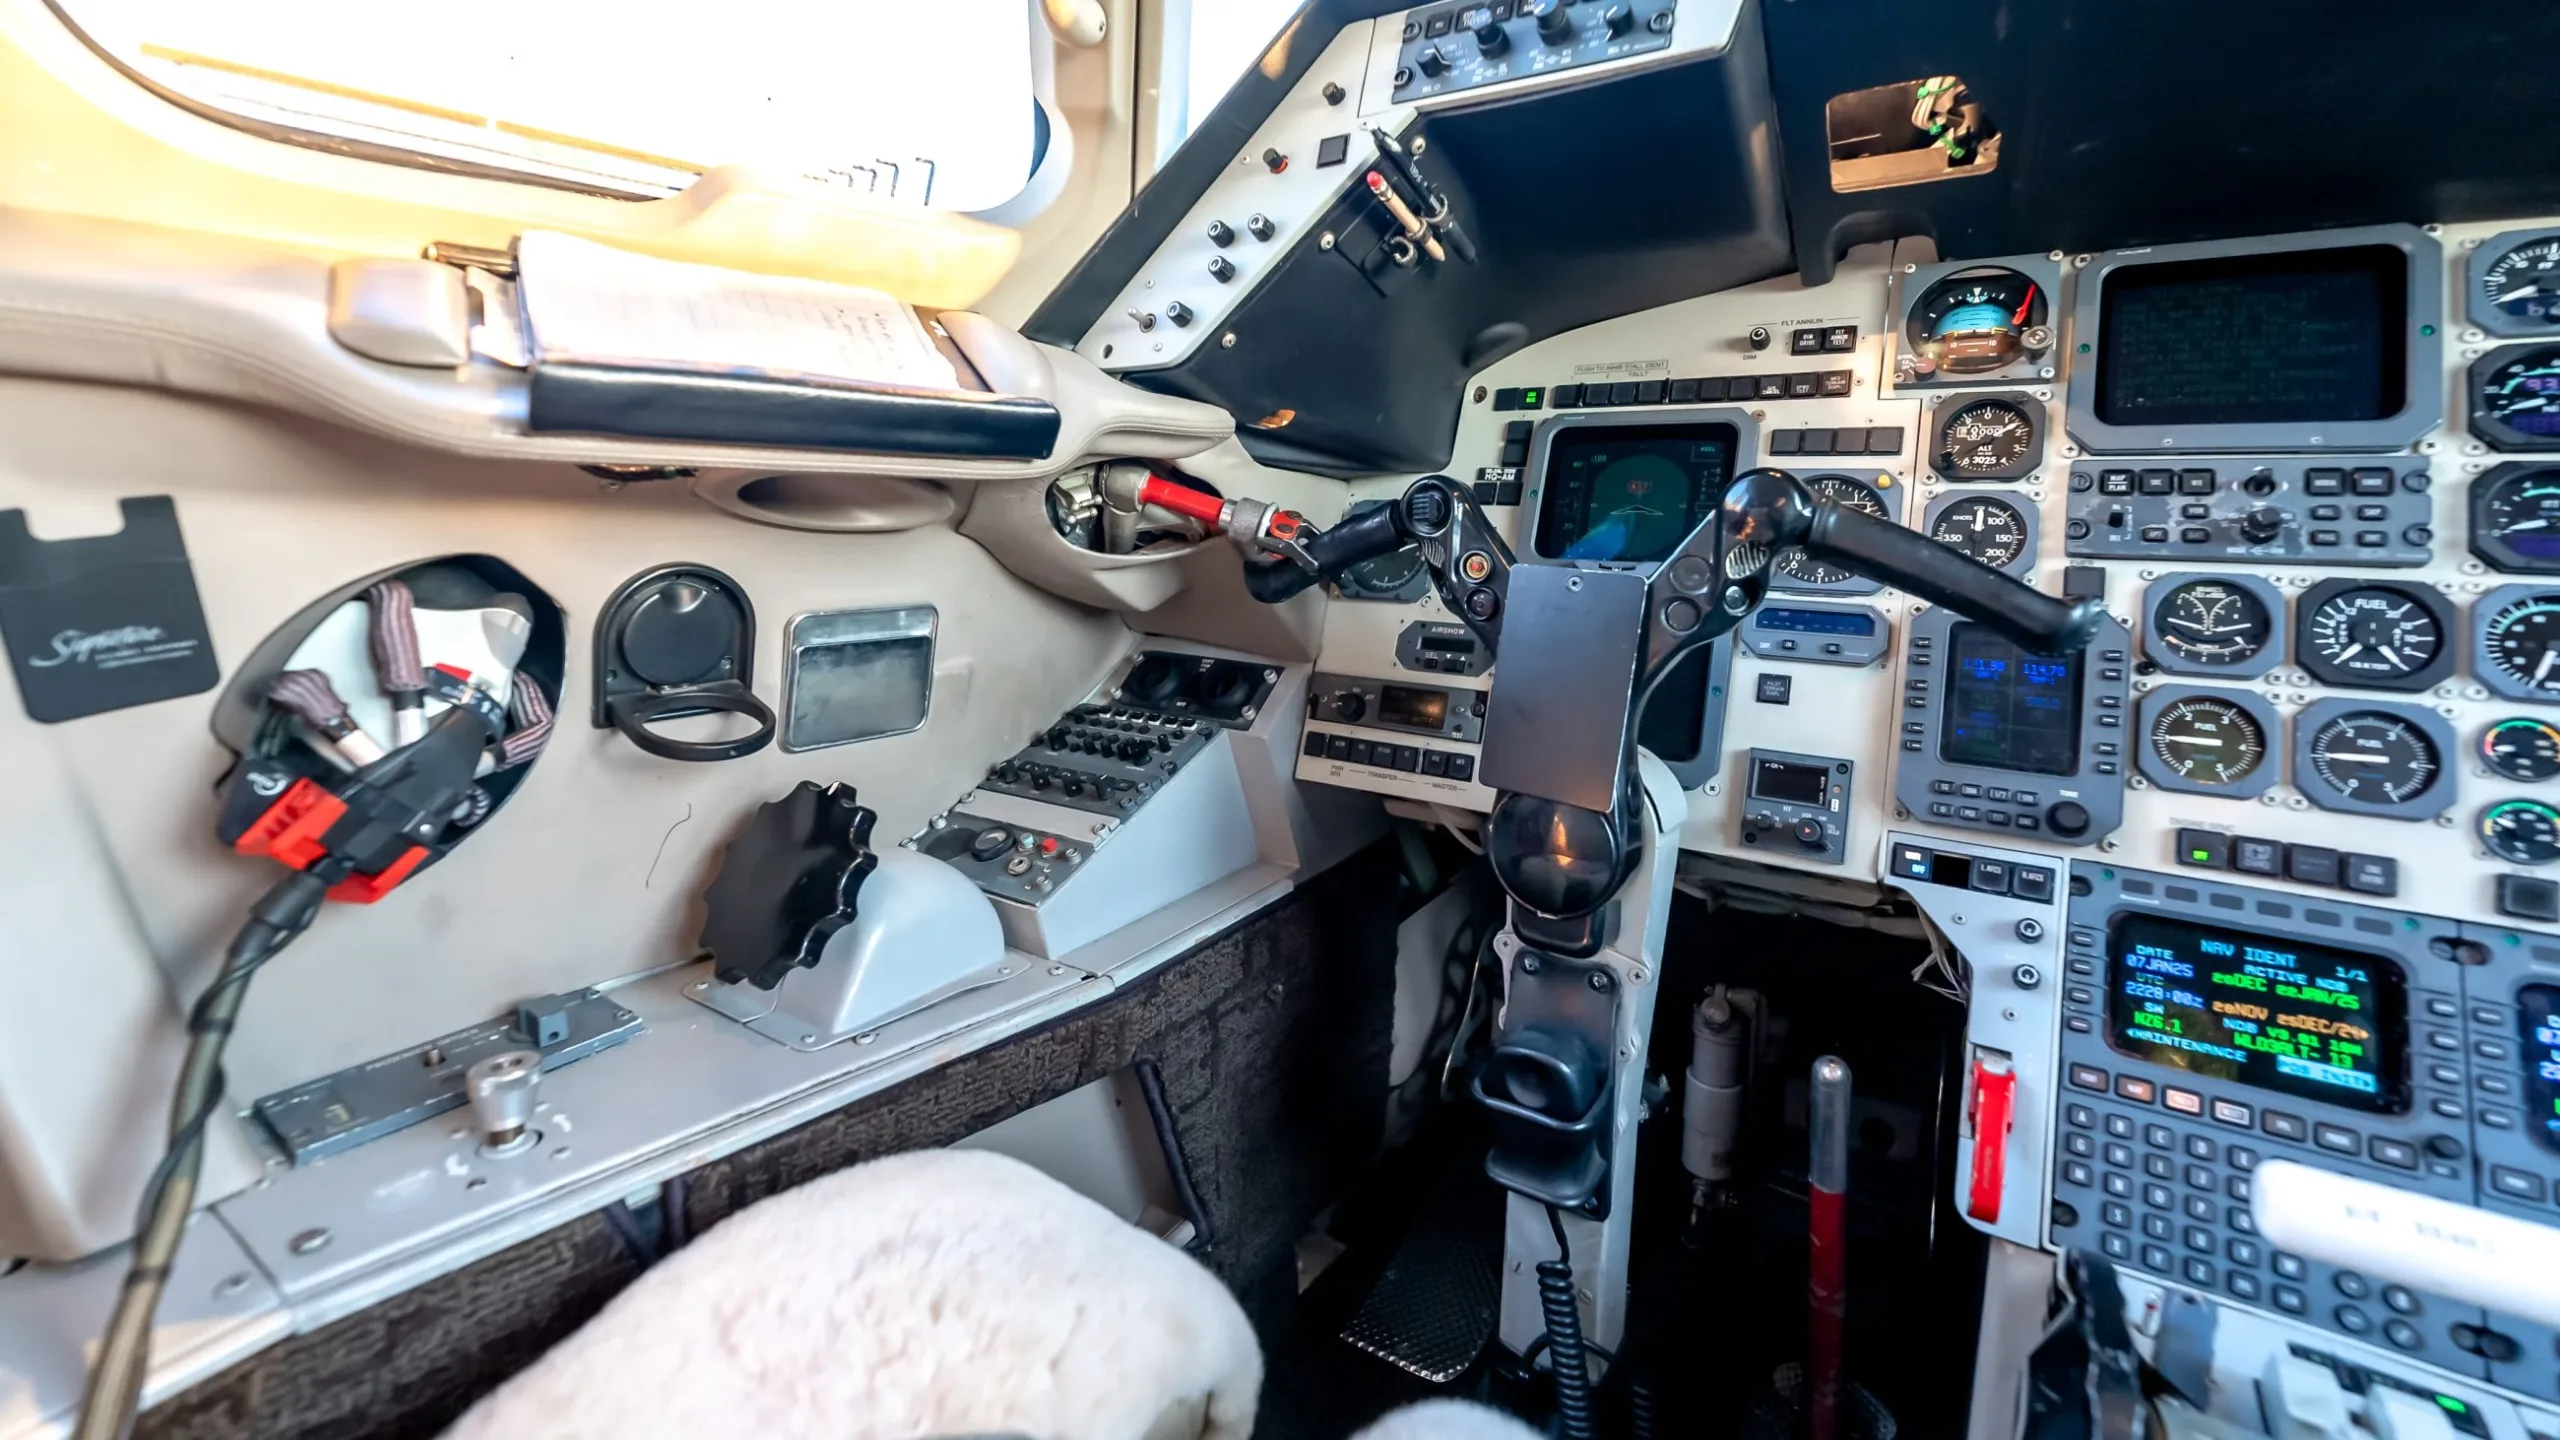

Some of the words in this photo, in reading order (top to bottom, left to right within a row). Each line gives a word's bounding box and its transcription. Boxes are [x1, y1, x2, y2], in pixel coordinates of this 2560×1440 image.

[2015, 428, 2021, 436] 2
[1962, 457, 1969, 465] 6
[1972, 456, 1997, 464] 3025
[1826, 488, 1834, 496] 0
[1987, 517, 2005, 525] 100
[1943, 534, 1963, 542] 350
[1995, 534, 2013, 542] 150
[1790, 560, 1798, 569] 6
[1816, 568, 1824, 577] 5
[2354, 599, 2389, 609] FUEL
[1431, 626, 1465, 635] AIRSHOW
[2184, 712, 2193, 720] 2
[2221, 716, 2229, 724] 3
[2194, 722, 2217, 731] FUEL
[2345, 728, 2355, 737] 2
[2386, 731, 2397, 741] 3
[2356, 738, 2384, 748] FUEL
[2184, 760, 2194, 768] 0
[1432, 782, 1458, 792] MASTER
[2347, 778, 2359, 788] 0
[2135, 944, 2174, 960] DATE
[2200, 939, 2235, 957] NAV
[2243, 946, 2297, 969] IDENT
[2125, 953, 2194, 978] 07JAN25
[2135, 971, 2164, 986] UTC
[2243, 964, 2308, 986] ACTIVE
[2315, 977, 2350, 993] NDB
[2335, 966, 2369, 982] 1/1
[2133, 1010, 2183, 1035] NZ6.1
[2130, 1029, 2248, 1063] MAINTENANCE
[2328, 1051, 2354, 1070] 13
[2077, 1110, 2088, 1123] A
[2156, 1131, 2166, 1145] C
[2113, 1208, 2123, 1223] S
[2155, 1220, 2165, 1235] T
[2112, 1238, 2122, 1253] X
[2154, 1251, 2165, 1266] Y
[2196, 1264, 2207, 1280] Z
